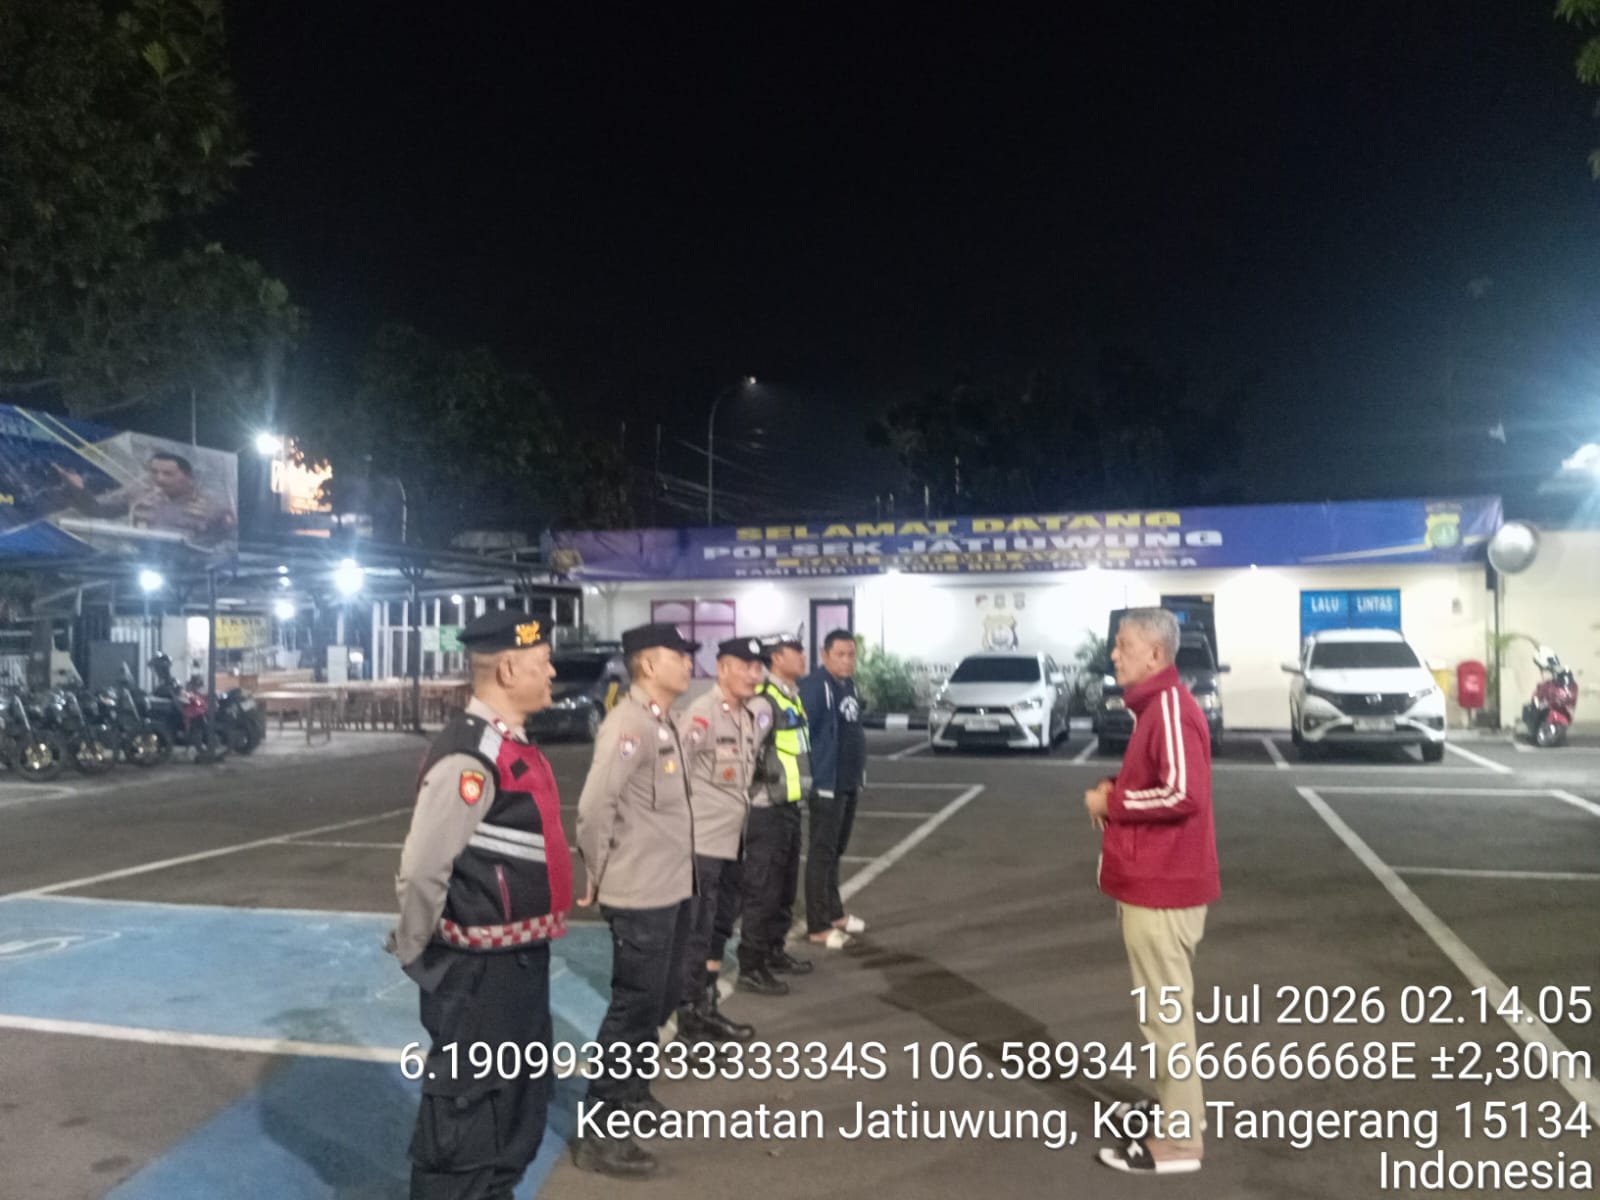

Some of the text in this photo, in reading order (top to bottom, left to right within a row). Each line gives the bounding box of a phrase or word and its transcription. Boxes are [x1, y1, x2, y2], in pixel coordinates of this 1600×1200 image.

[736, 511, 1181, 541] SELAMAT DATANG
[704, 530, 1223, 560] POLSEK JATIUWUNG
[1311, 596, 1393, 613] LALU LINTAS
